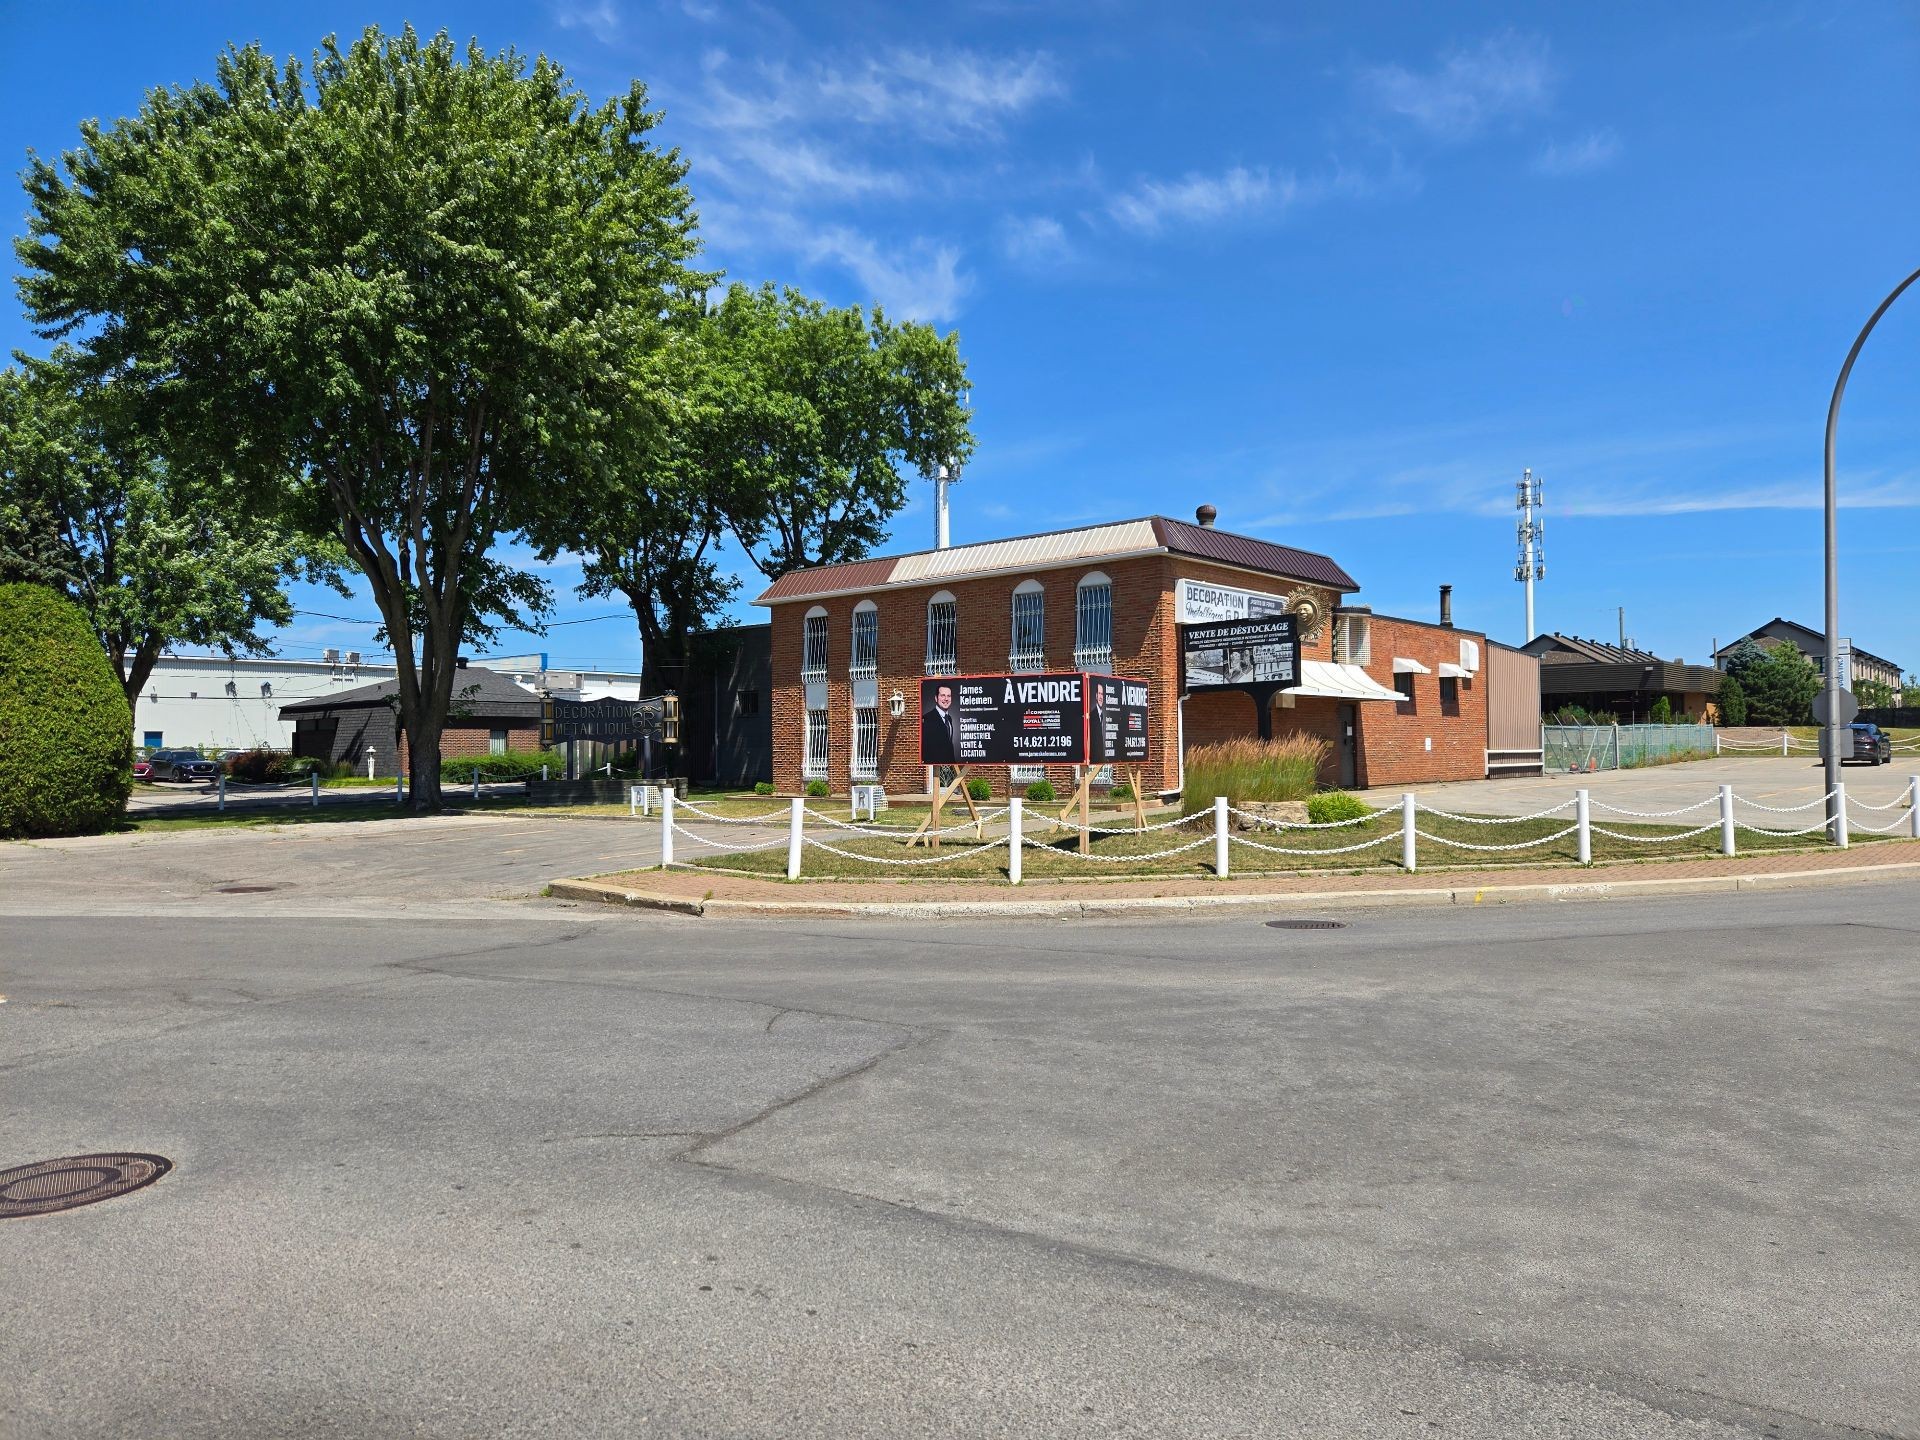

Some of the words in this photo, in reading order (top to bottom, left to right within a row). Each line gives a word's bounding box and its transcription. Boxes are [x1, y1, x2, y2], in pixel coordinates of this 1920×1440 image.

[1189, 630, 1216, 639] VENTE
[1217, 628, 1229, 637] DE
[1230, 622, 1289, 635] DÉSTOCKAGE
[960, 685, 984, 694] James
[1003, 678, 1015, 703] À
[1017, 681, 1081, 703] VENDRE
[960, 696, 993, 705] Kelemen
[1127, 686, 1148, 706] VENDRE
[555, 704, 632, 719] DÉCORATION
[960, 723, 995, 731] COMMERCIAL
[960, 732, 991, 740] INDUSTRIEL
[960, 741, 977, 749] VENTE
[978, 740, 982, 749] &
[1013, 736, 1072, 748] 514.621.2196
[960, 749, 986, 758] LOCATION
